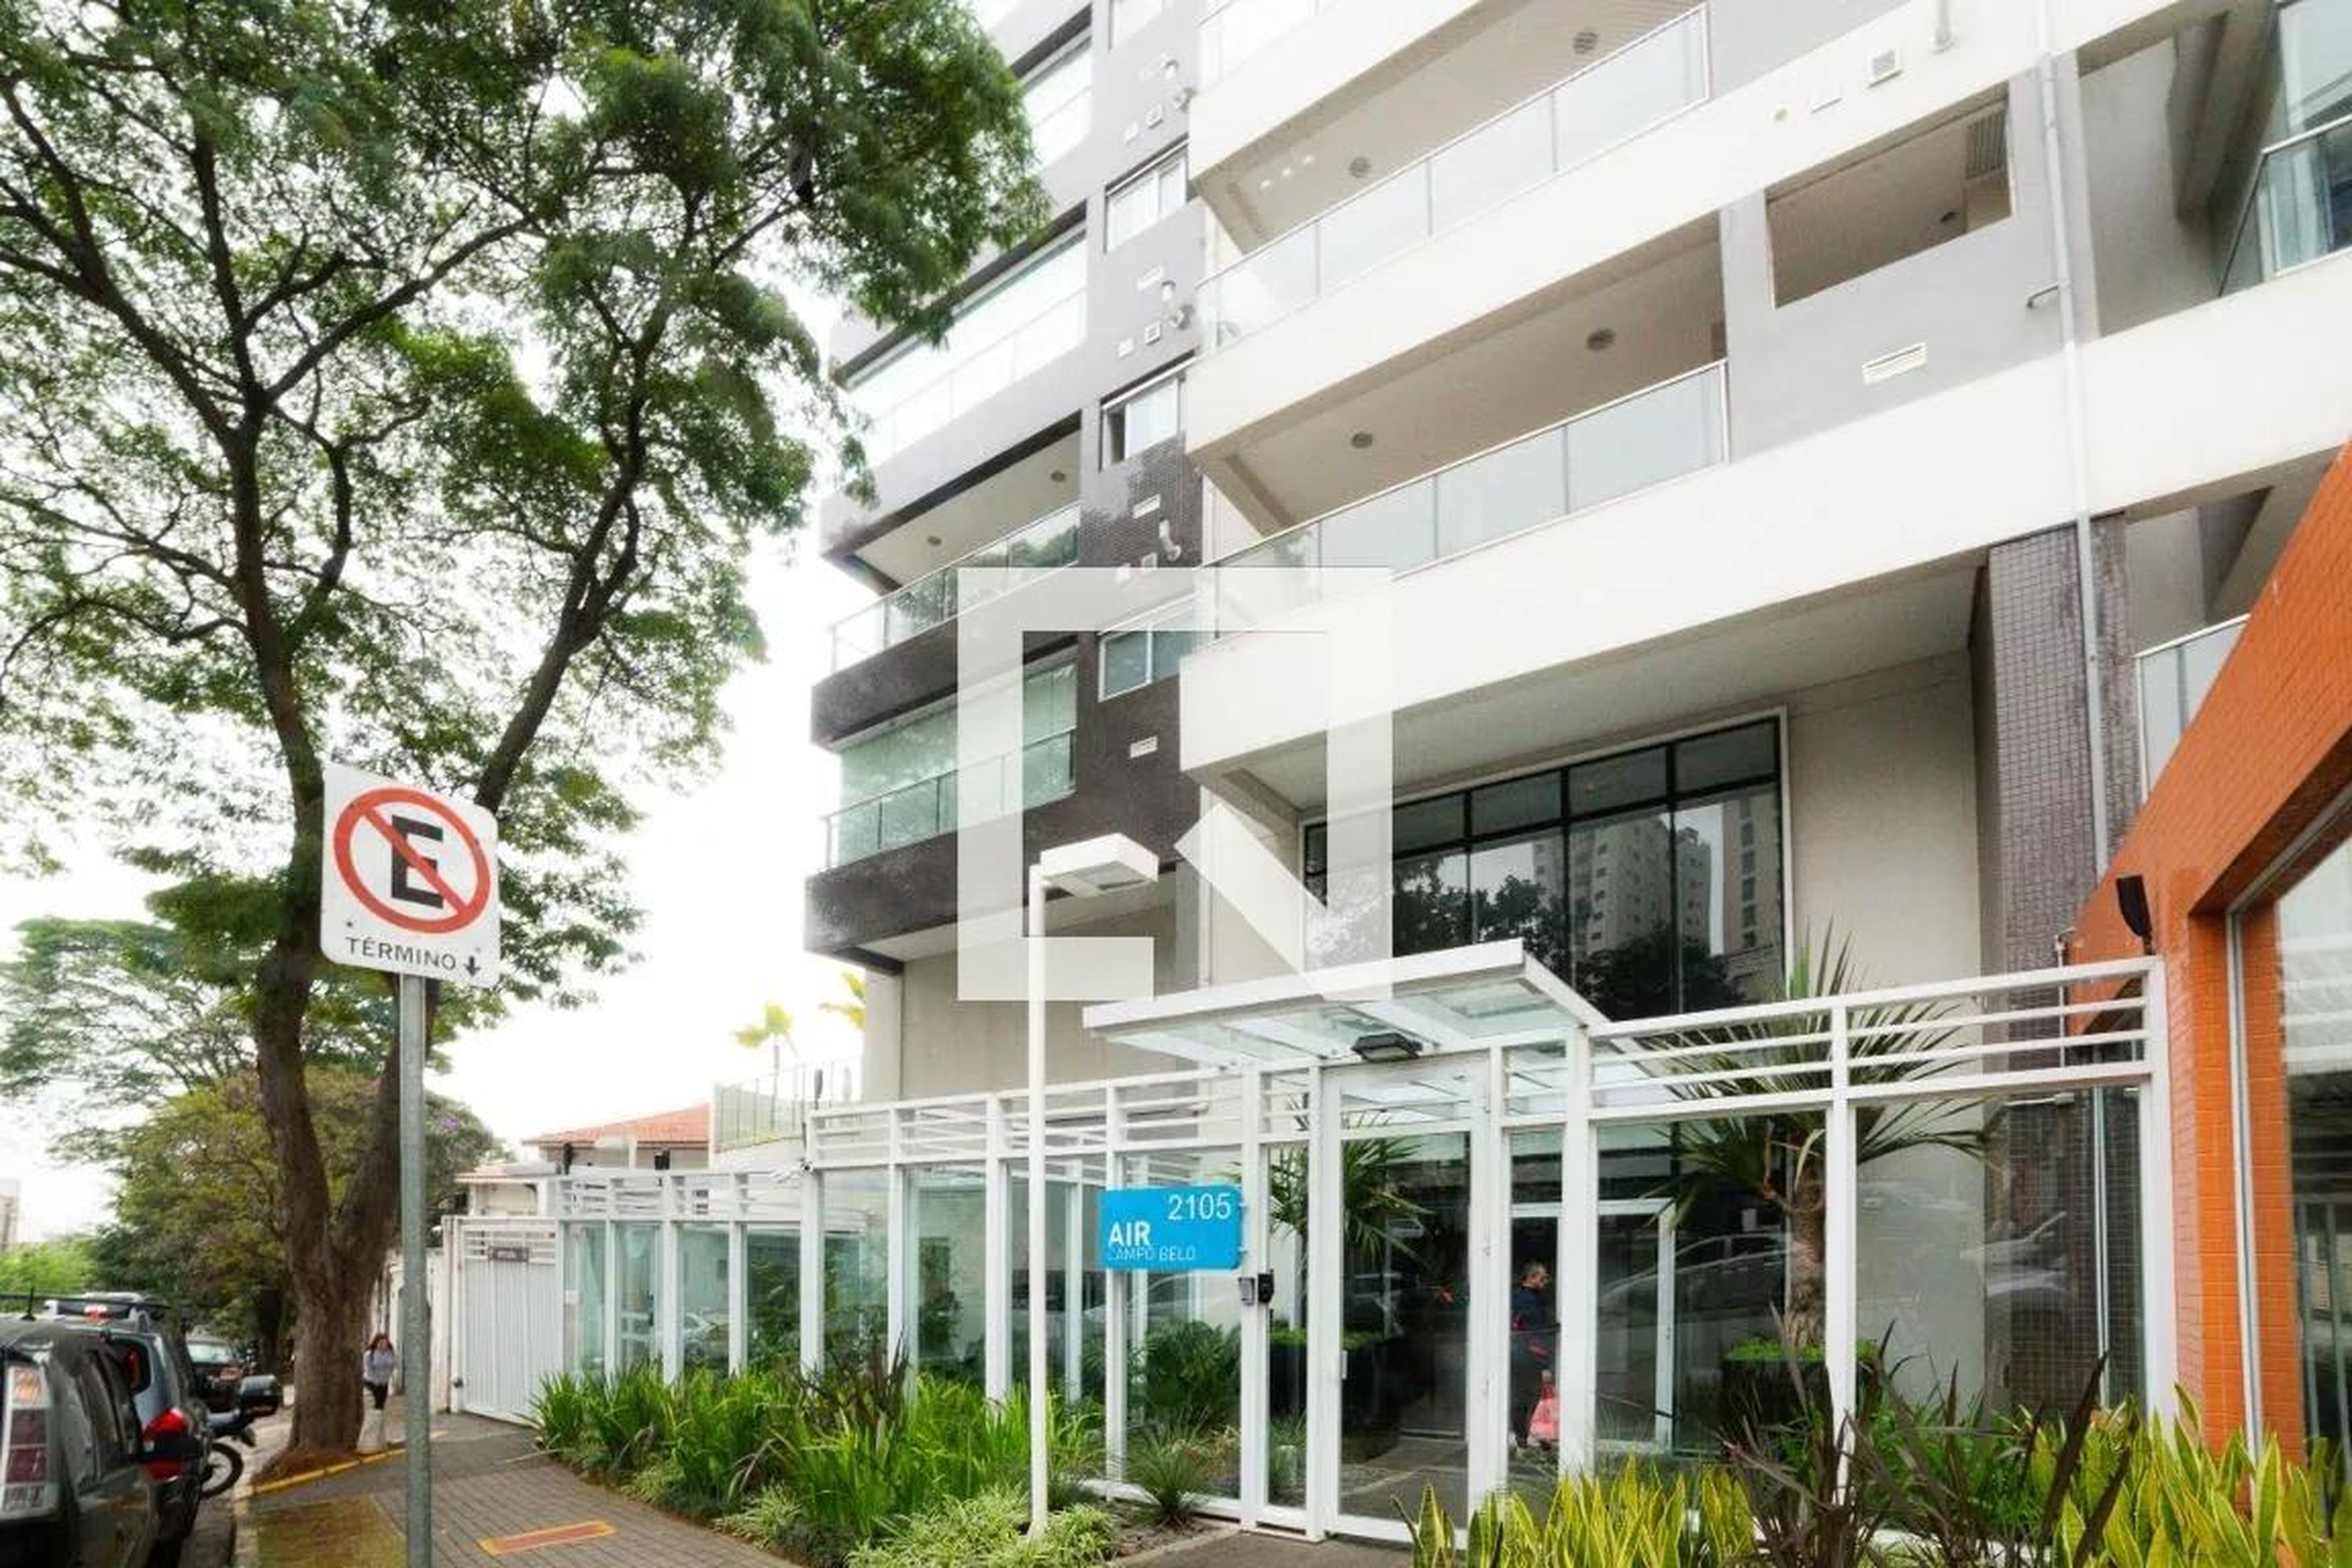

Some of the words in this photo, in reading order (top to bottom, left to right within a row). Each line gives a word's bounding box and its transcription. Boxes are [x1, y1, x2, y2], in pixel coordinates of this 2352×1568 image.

[391, 815, 443, 909] E
[345, 937, 456, 970] TÉRMINO
[1168, 1193, 1232, 1220] 2105
[1109, 1221, 1150, 1247] AIR
[1159, 1245, 1195, 1261] BELO
